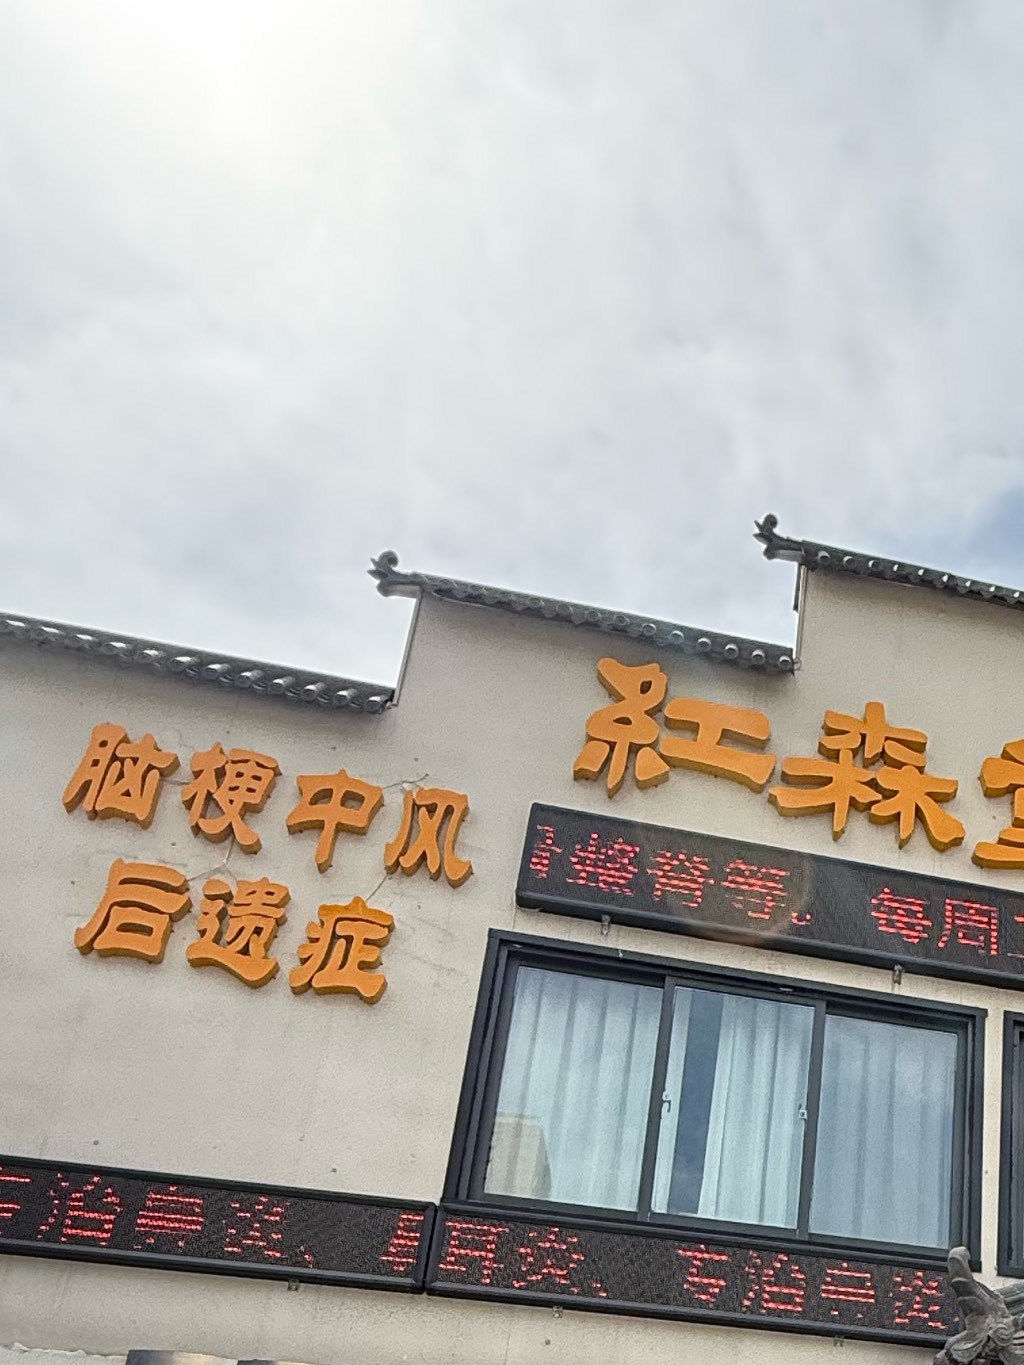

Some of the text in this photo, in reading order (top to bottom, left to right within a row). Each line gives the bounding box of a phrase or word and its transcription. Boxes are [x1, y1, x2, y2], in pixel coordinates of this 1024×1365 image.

[62, 723, 472, 888] 脑梗中风
[73, 858, 395, 1005] 后遗症
